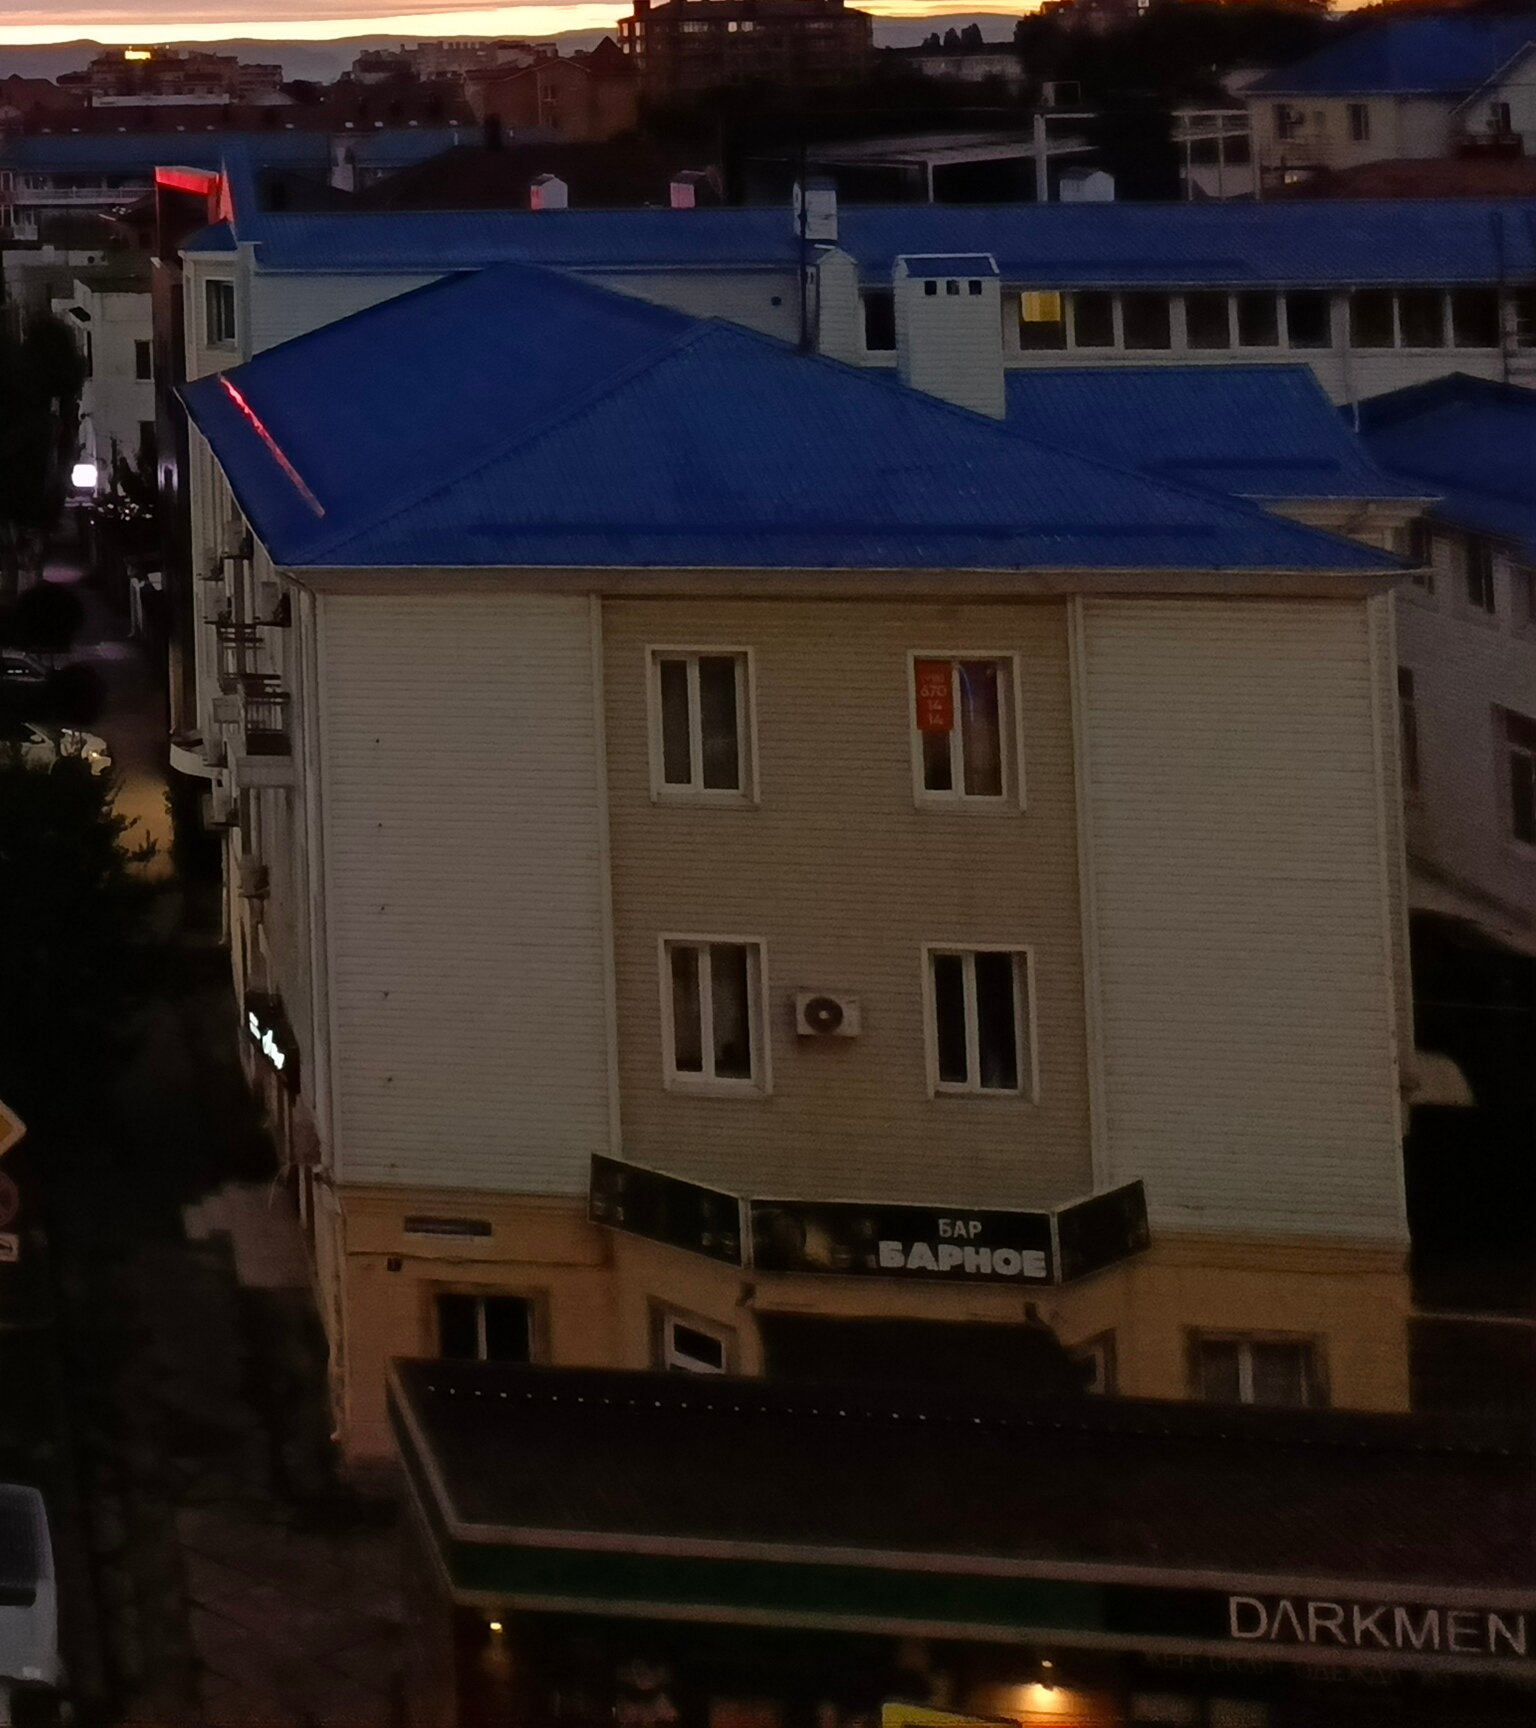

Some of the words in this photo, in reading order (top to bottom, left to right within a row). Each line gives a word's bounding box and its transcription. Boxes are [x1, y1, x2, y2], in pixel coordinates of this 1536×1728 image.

[938, 1217, 983, 1239] БАР
[878, 1239, 1048, 1279] БАРНОЕ
[1228, 1595, 1528, 1657] DARKMEN
